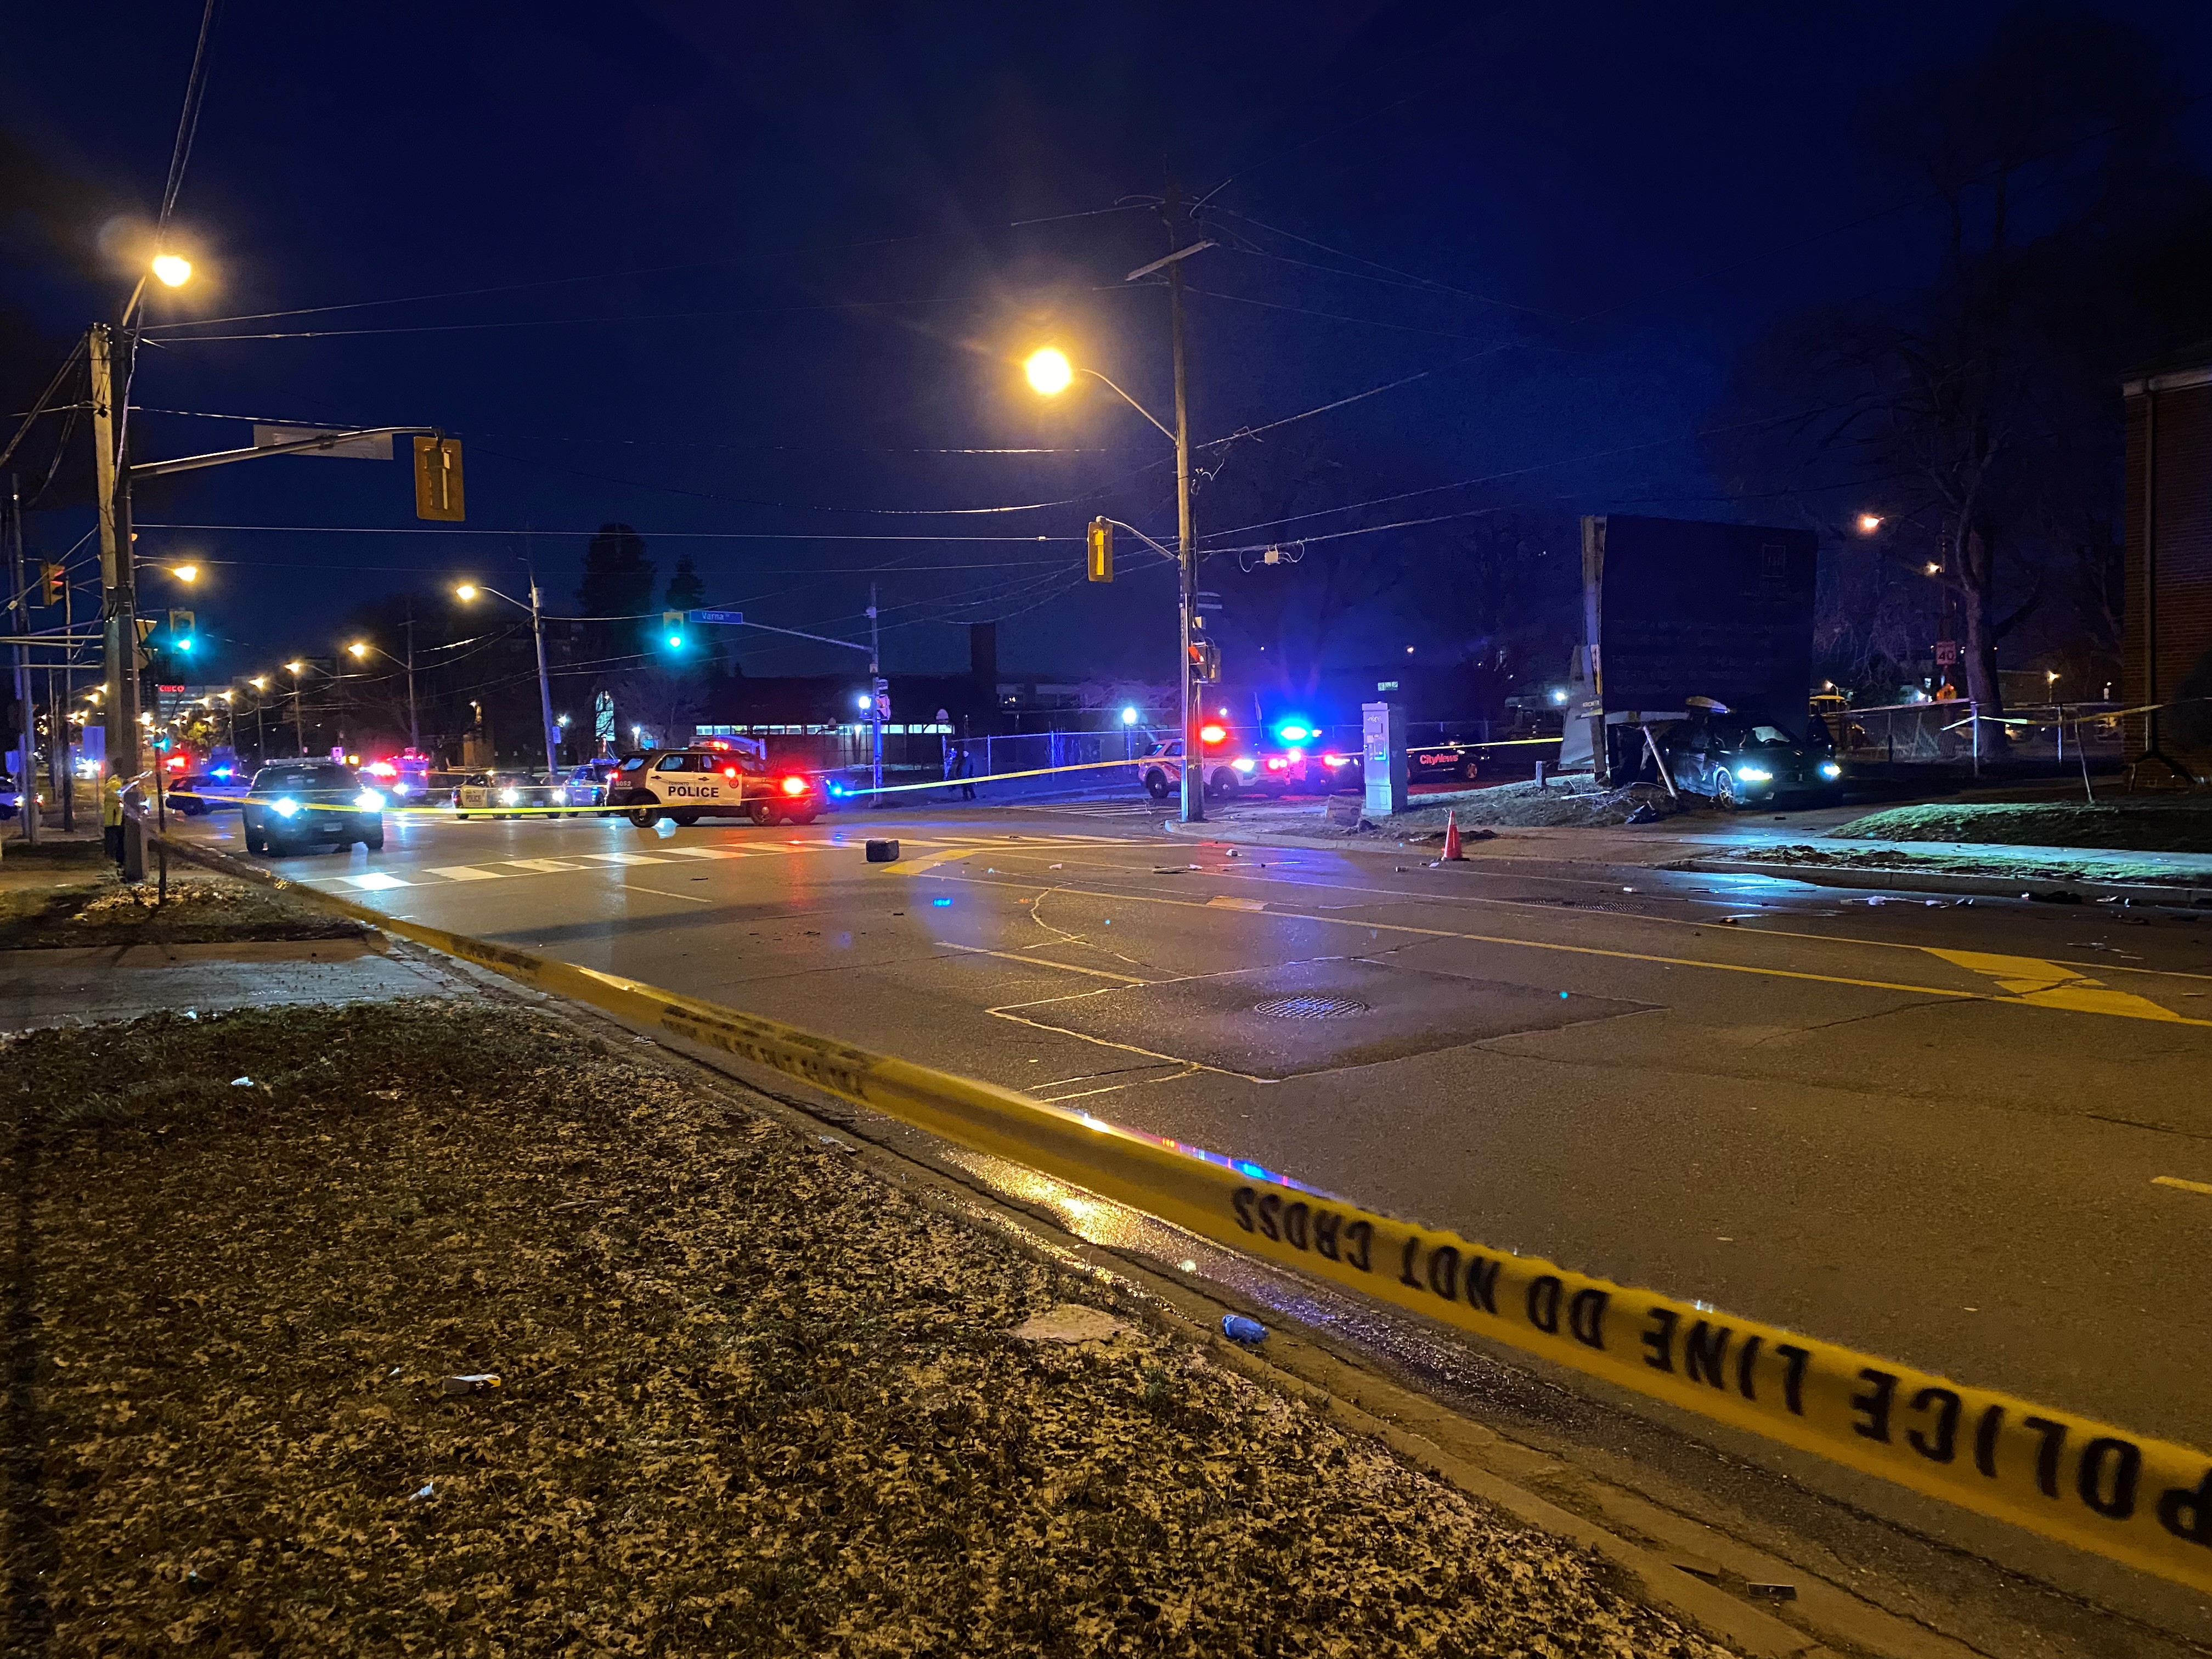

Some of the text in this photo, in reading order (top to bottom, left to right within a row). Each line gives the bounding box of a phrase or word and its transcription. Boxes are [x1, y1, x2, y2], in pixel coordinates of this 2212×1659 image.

[702, 611, 724, 620] Varna
[1938, 651, 1954, 661] 40
[1420, 754, 1459, 765] CityNews
[668, 786, 719, 798] POLICE
[1231, 1186, 2212, 1550] POLICE LINE DO NOT CROSS
